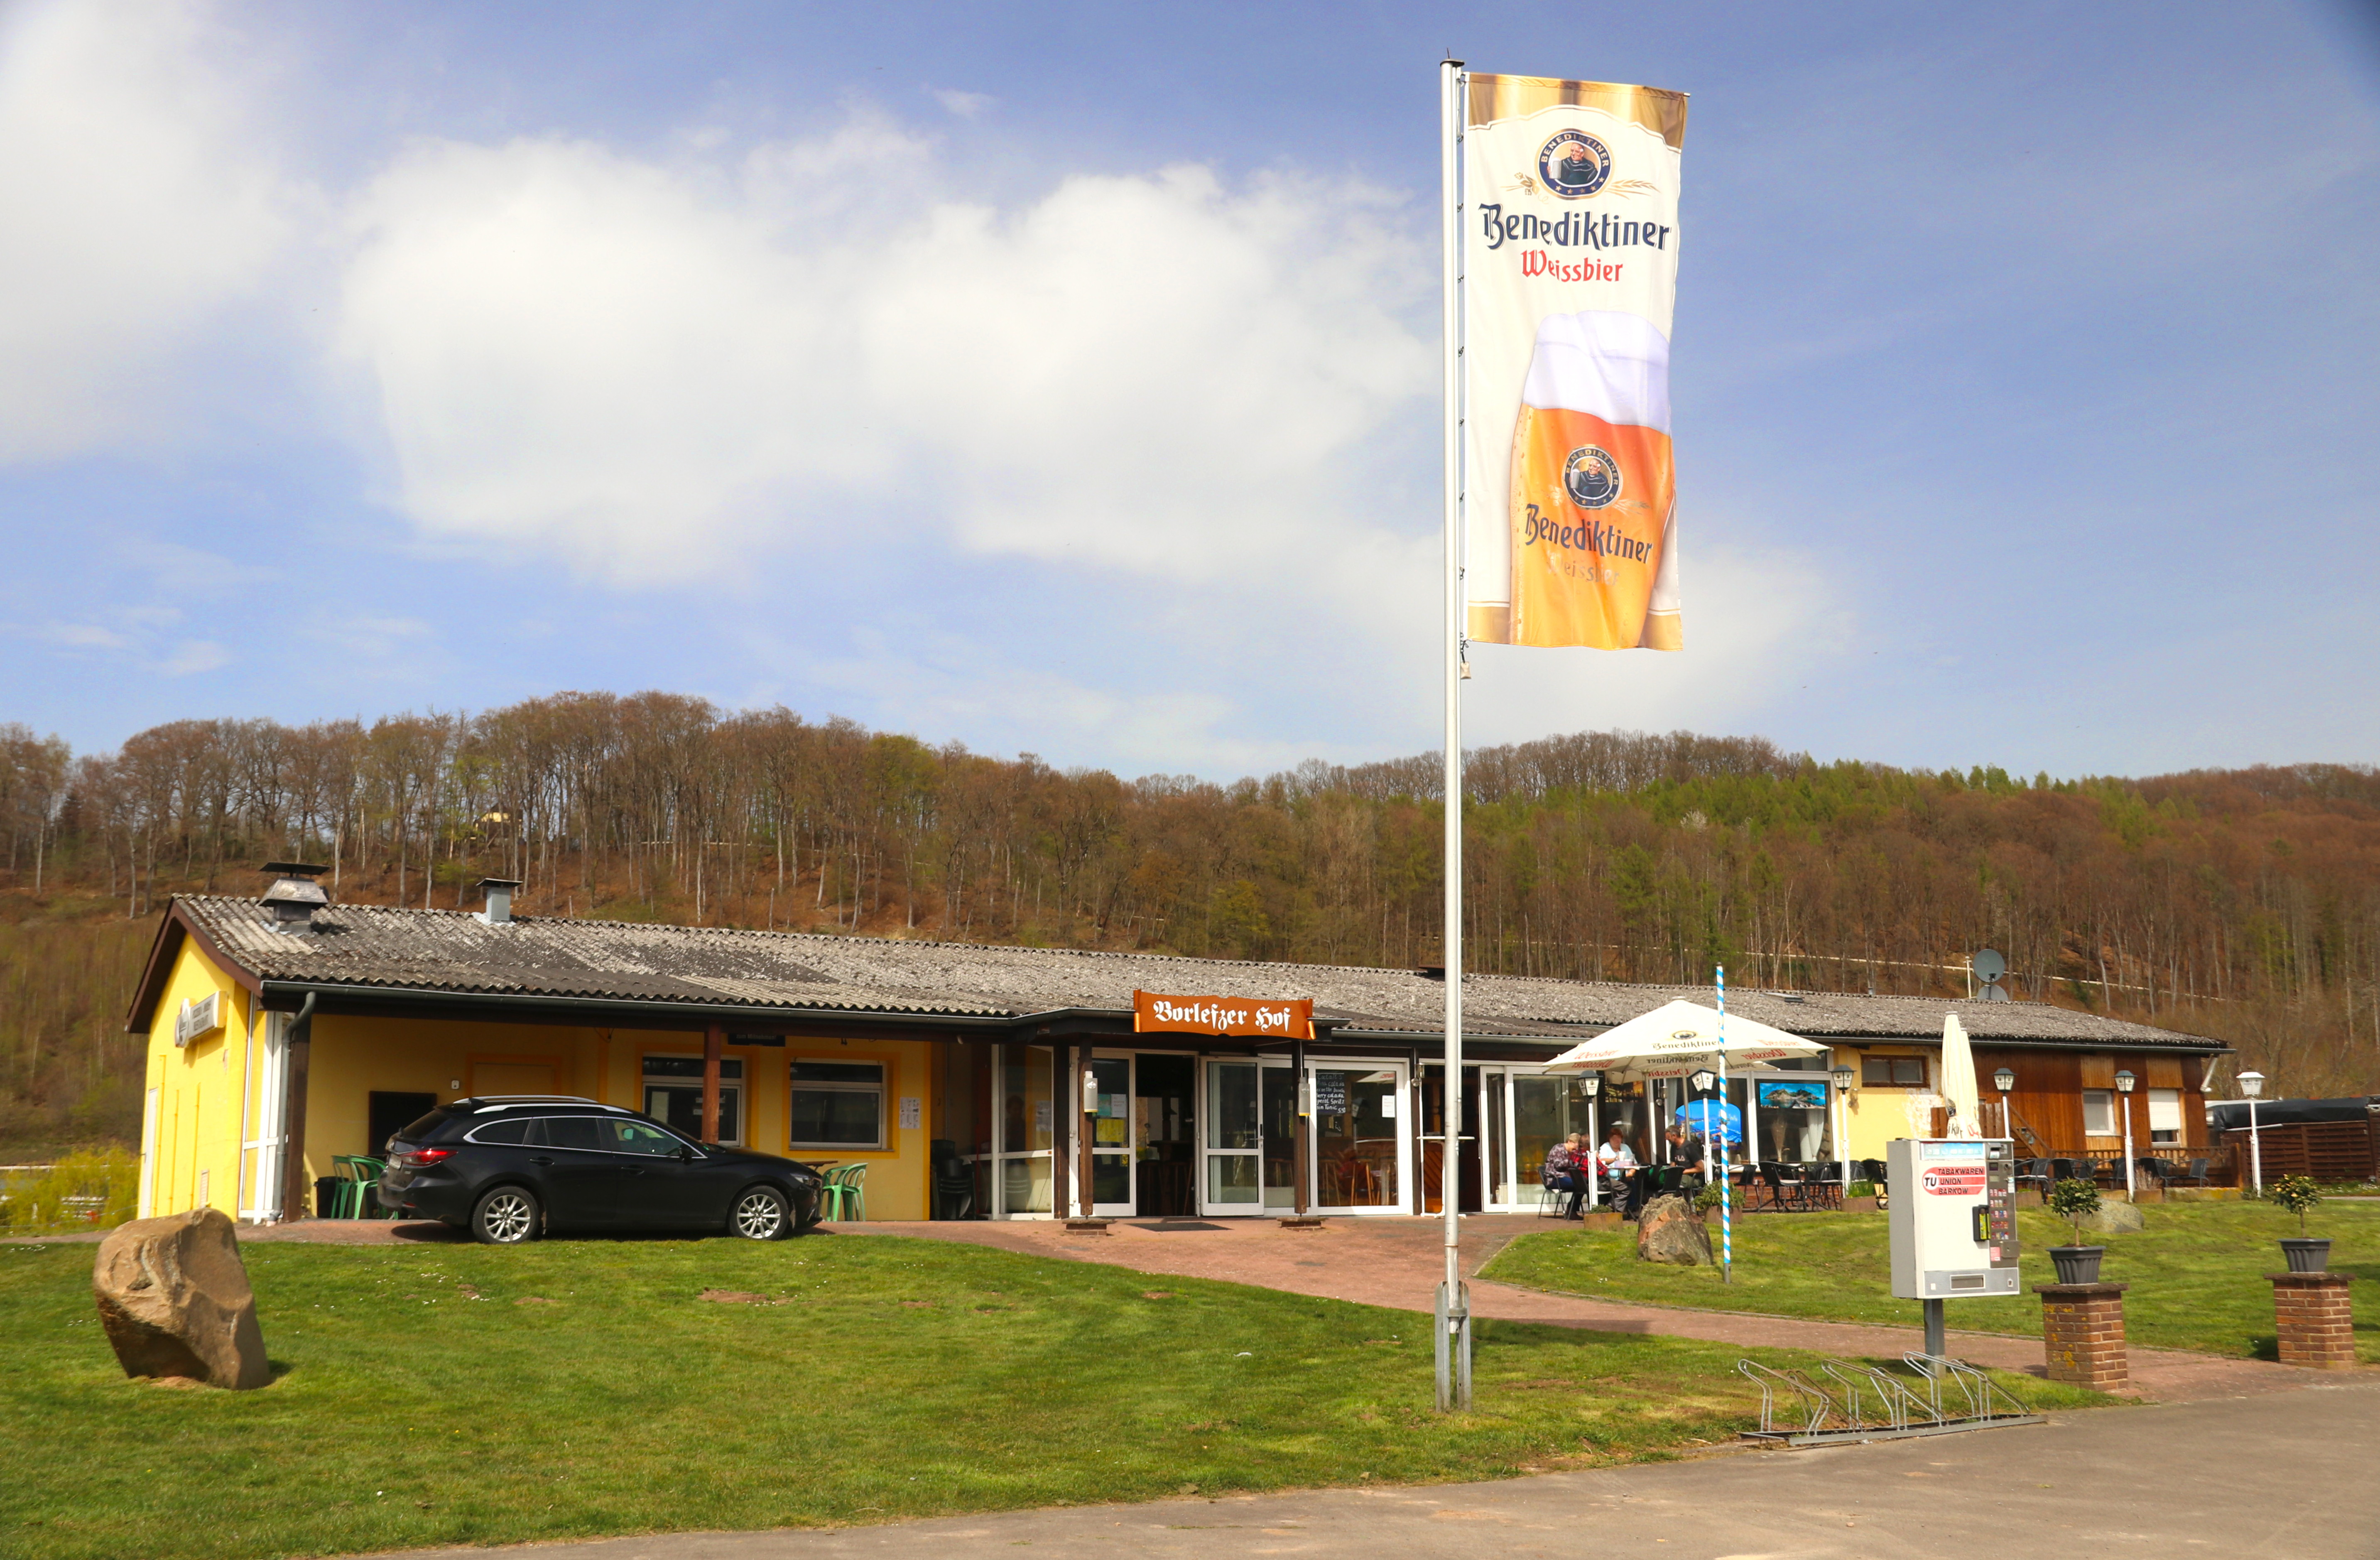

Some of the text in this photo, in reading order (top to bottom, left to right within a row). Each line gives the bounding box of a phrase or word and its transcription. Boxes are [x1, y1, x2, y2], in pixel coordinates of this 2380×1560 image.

[1541, 133, 1609, 167] BENEDIKTINER
[1478, 203, 1672, 251] Benediktiner
[1520, 249, 1623, 282] Weissbier
[1566, 449, 1618, 486] BENEDIKTINER
[1525, 503, 1653, 564] Benediktiner
[1255, 1006, 1291, 1032] Hof
[1924, 1177, 1937, 1187] TU
